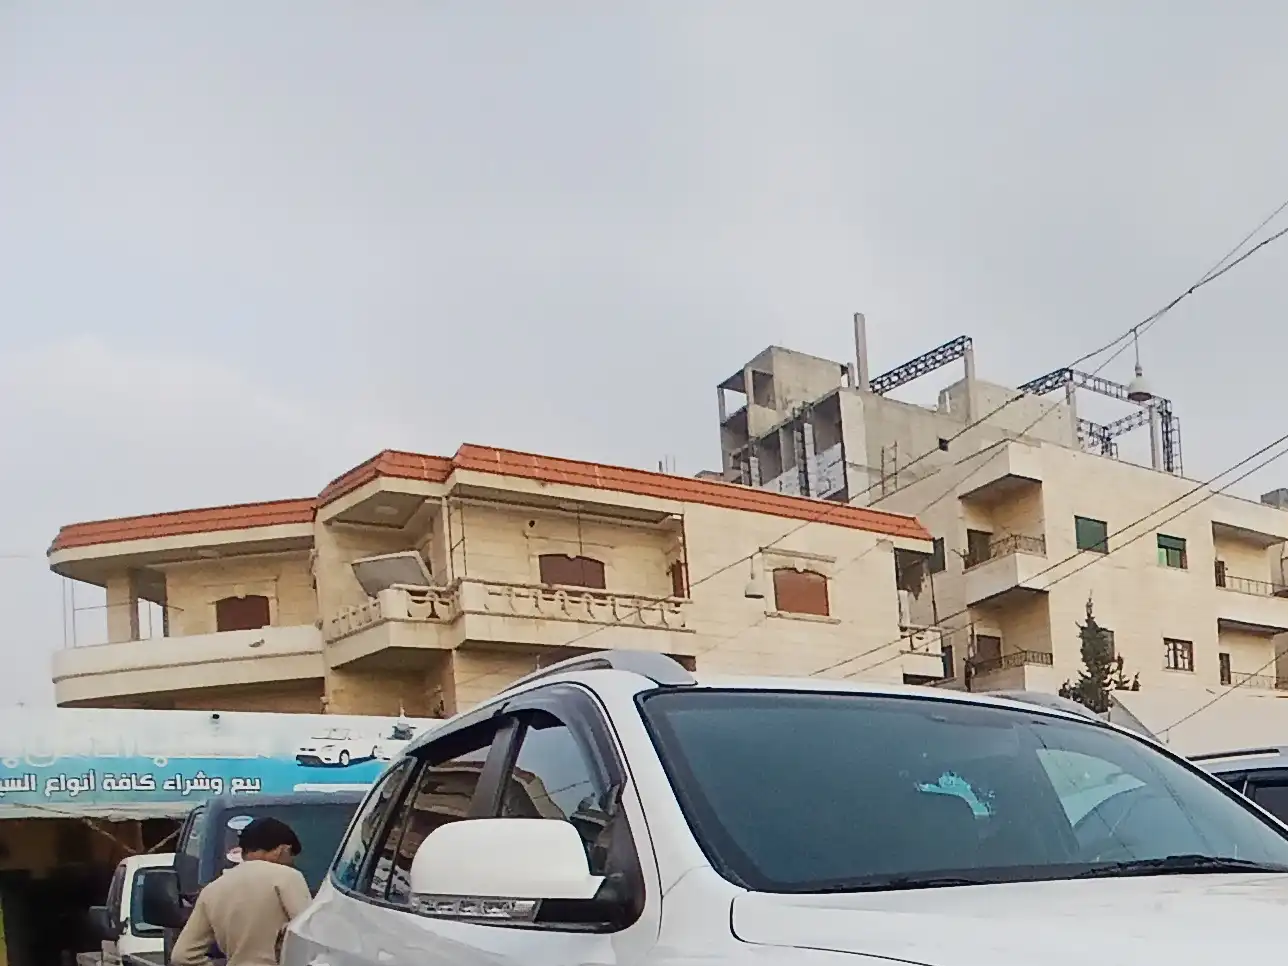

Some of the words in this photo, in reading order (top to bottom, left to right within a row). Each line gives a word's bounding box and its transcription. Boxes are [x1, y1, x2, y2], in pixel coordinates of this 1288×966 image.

[44, 768, 96, 798] أنواع
[102, 771, 156, 793] كافة
[162, 770, 225, 797] وشراء
[230, 776, 262, 797] بيع
